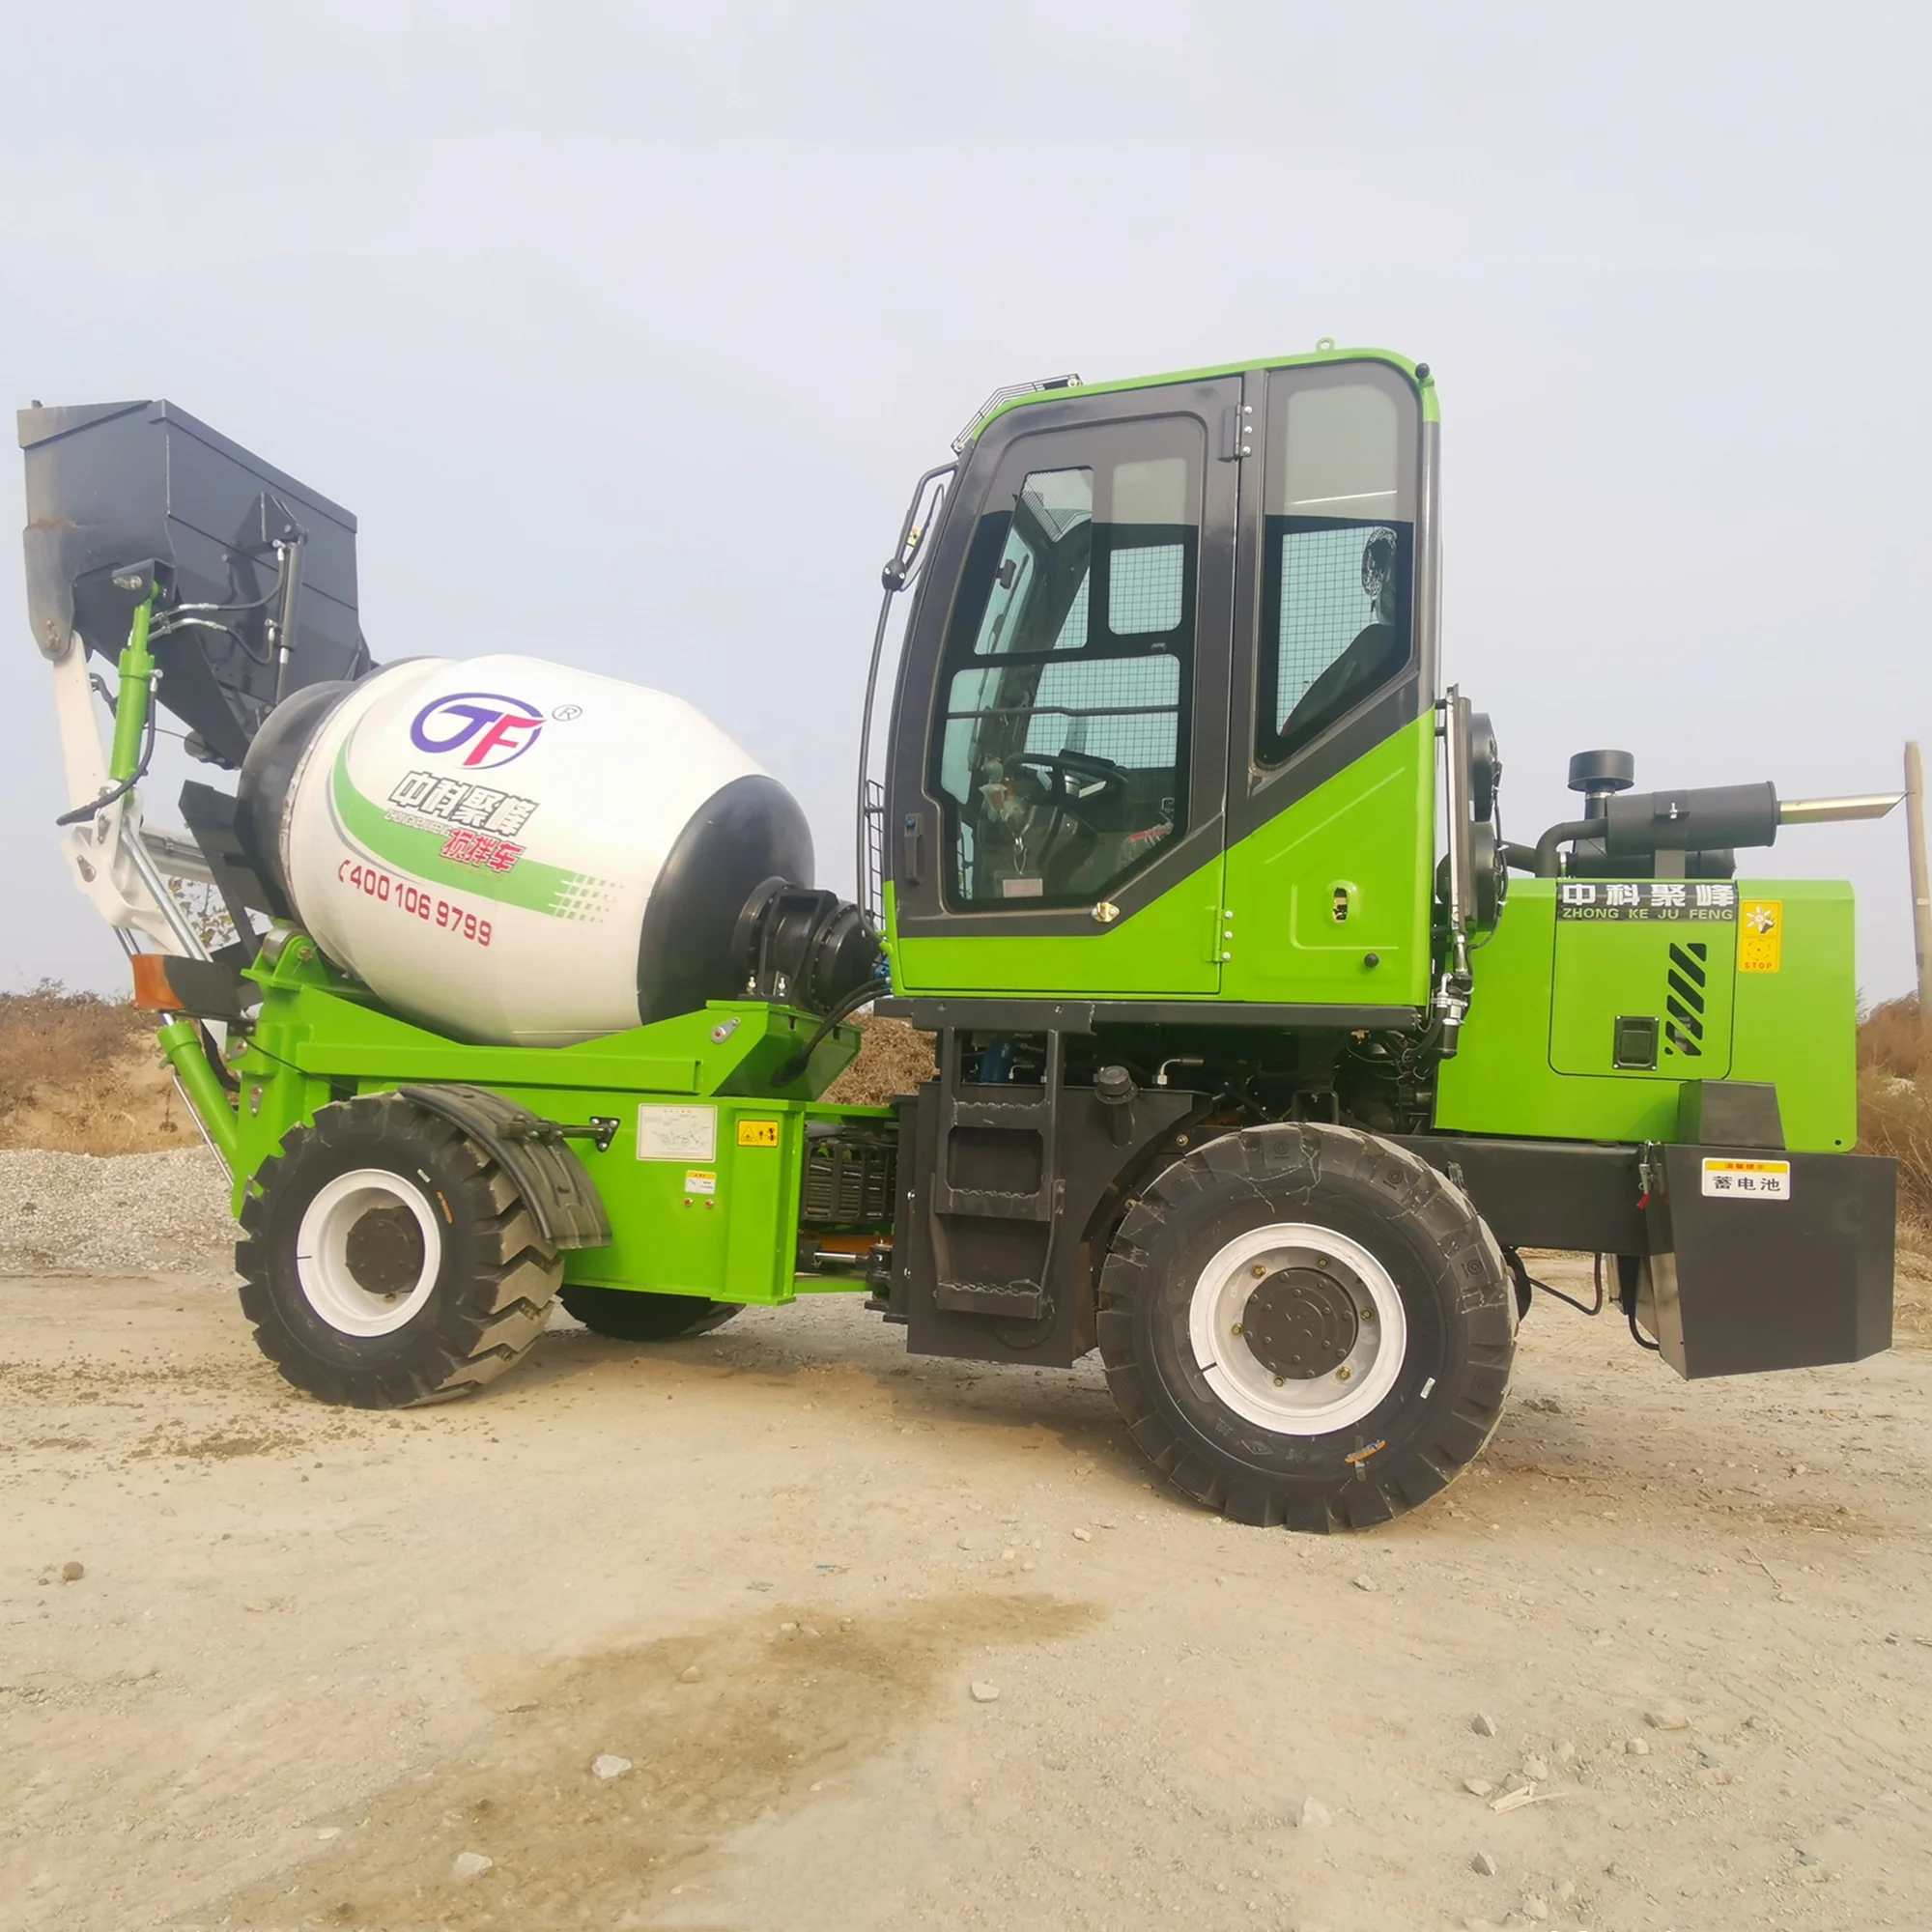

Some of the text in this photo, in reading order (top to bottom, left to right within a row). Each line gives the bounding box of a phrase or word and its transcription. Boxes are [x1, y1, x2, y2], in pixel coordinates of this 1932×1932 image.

[387, 771, 540, 837] 中科聚峰
[1562, 883, 1734, 907] 中科聚峰
[350, 865, 492, 947] 400 106 9799
[1562, 908, 1734, 920] ZHONG KE JU FENG
[1744, 961, 1773, 970] STOP
[1713, 1175, 1781, 1192] 蓄电池
